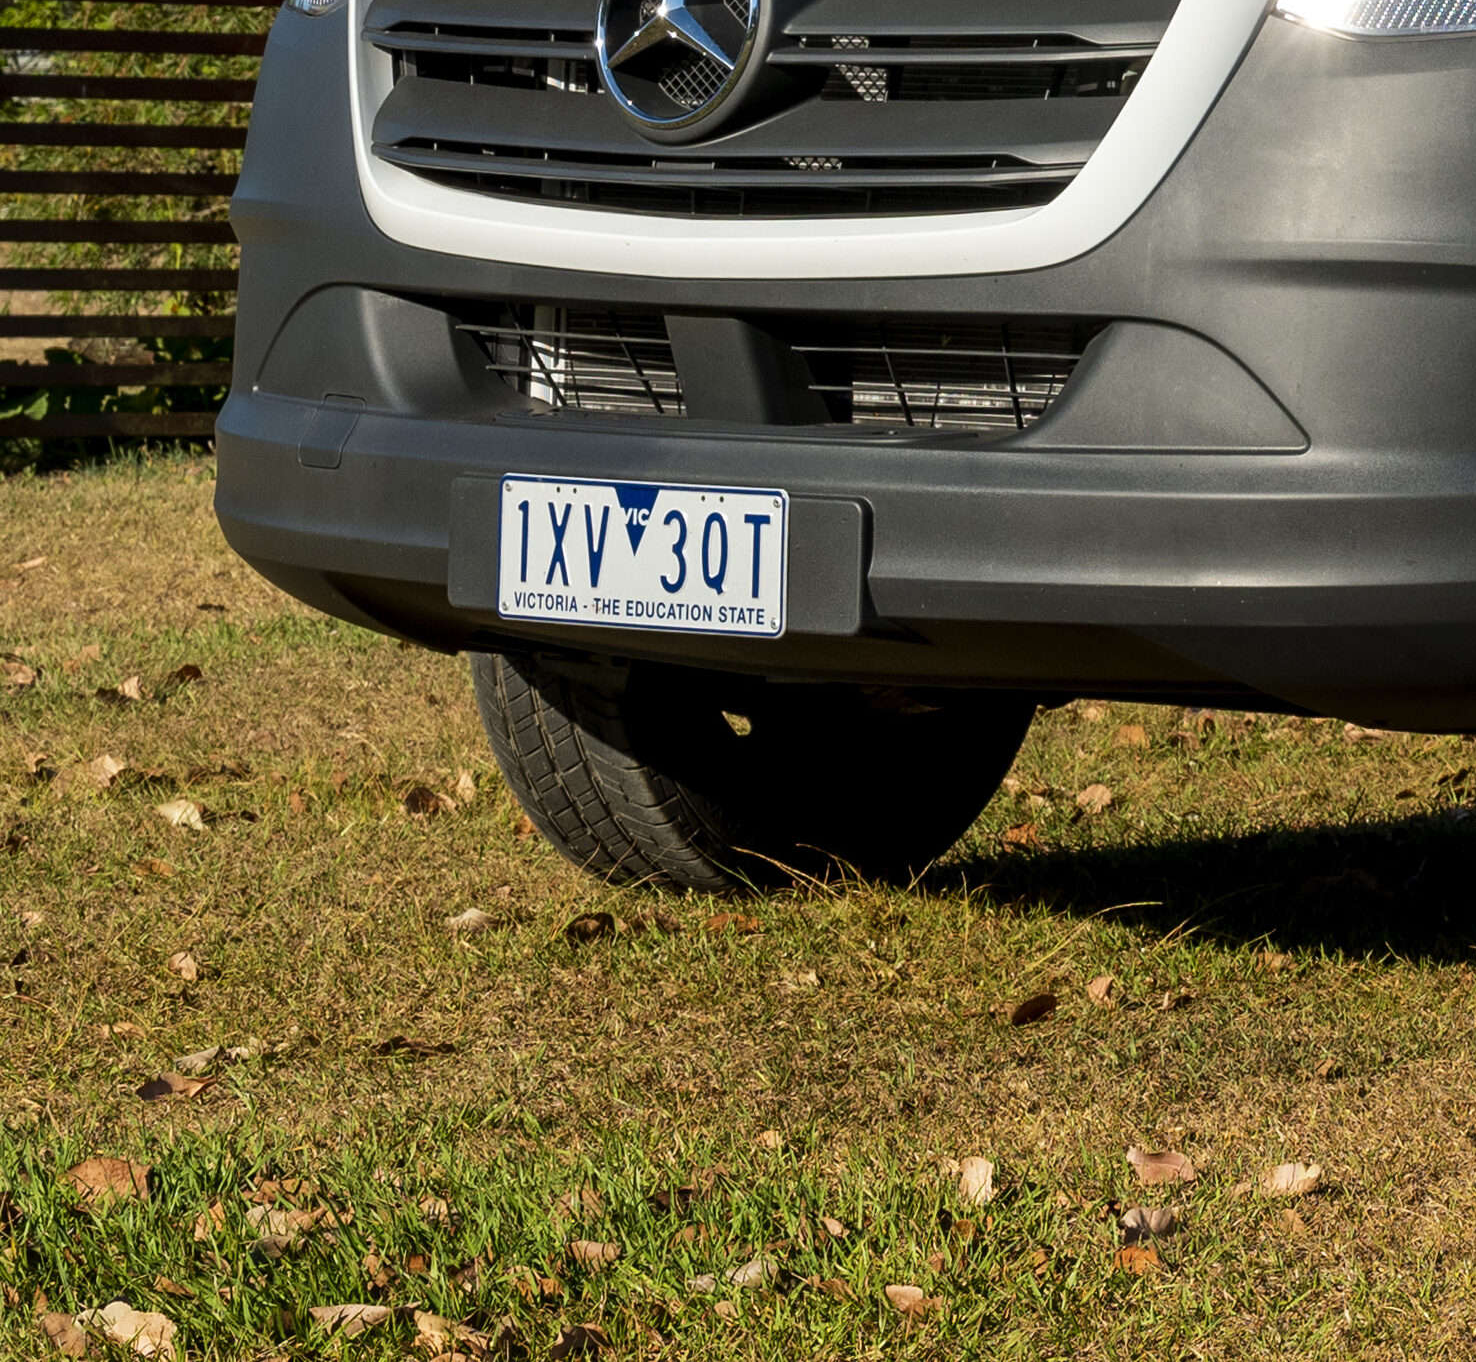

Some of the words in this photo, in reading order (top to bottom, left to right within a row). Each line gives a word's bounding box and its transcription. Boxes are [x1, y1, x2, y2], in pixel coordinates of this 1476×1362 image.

[621, 507, 650, 527] VIC
[518, 499, 611, 589] 1XV
[660, 509, 772, 599] 3QT
[514, 591, 578, 613] VICTORIA
[592, 597, 620, 617] THE
[626, 600, 713, 622] EDUCATION
[718, 606, 765, 626] STATE
